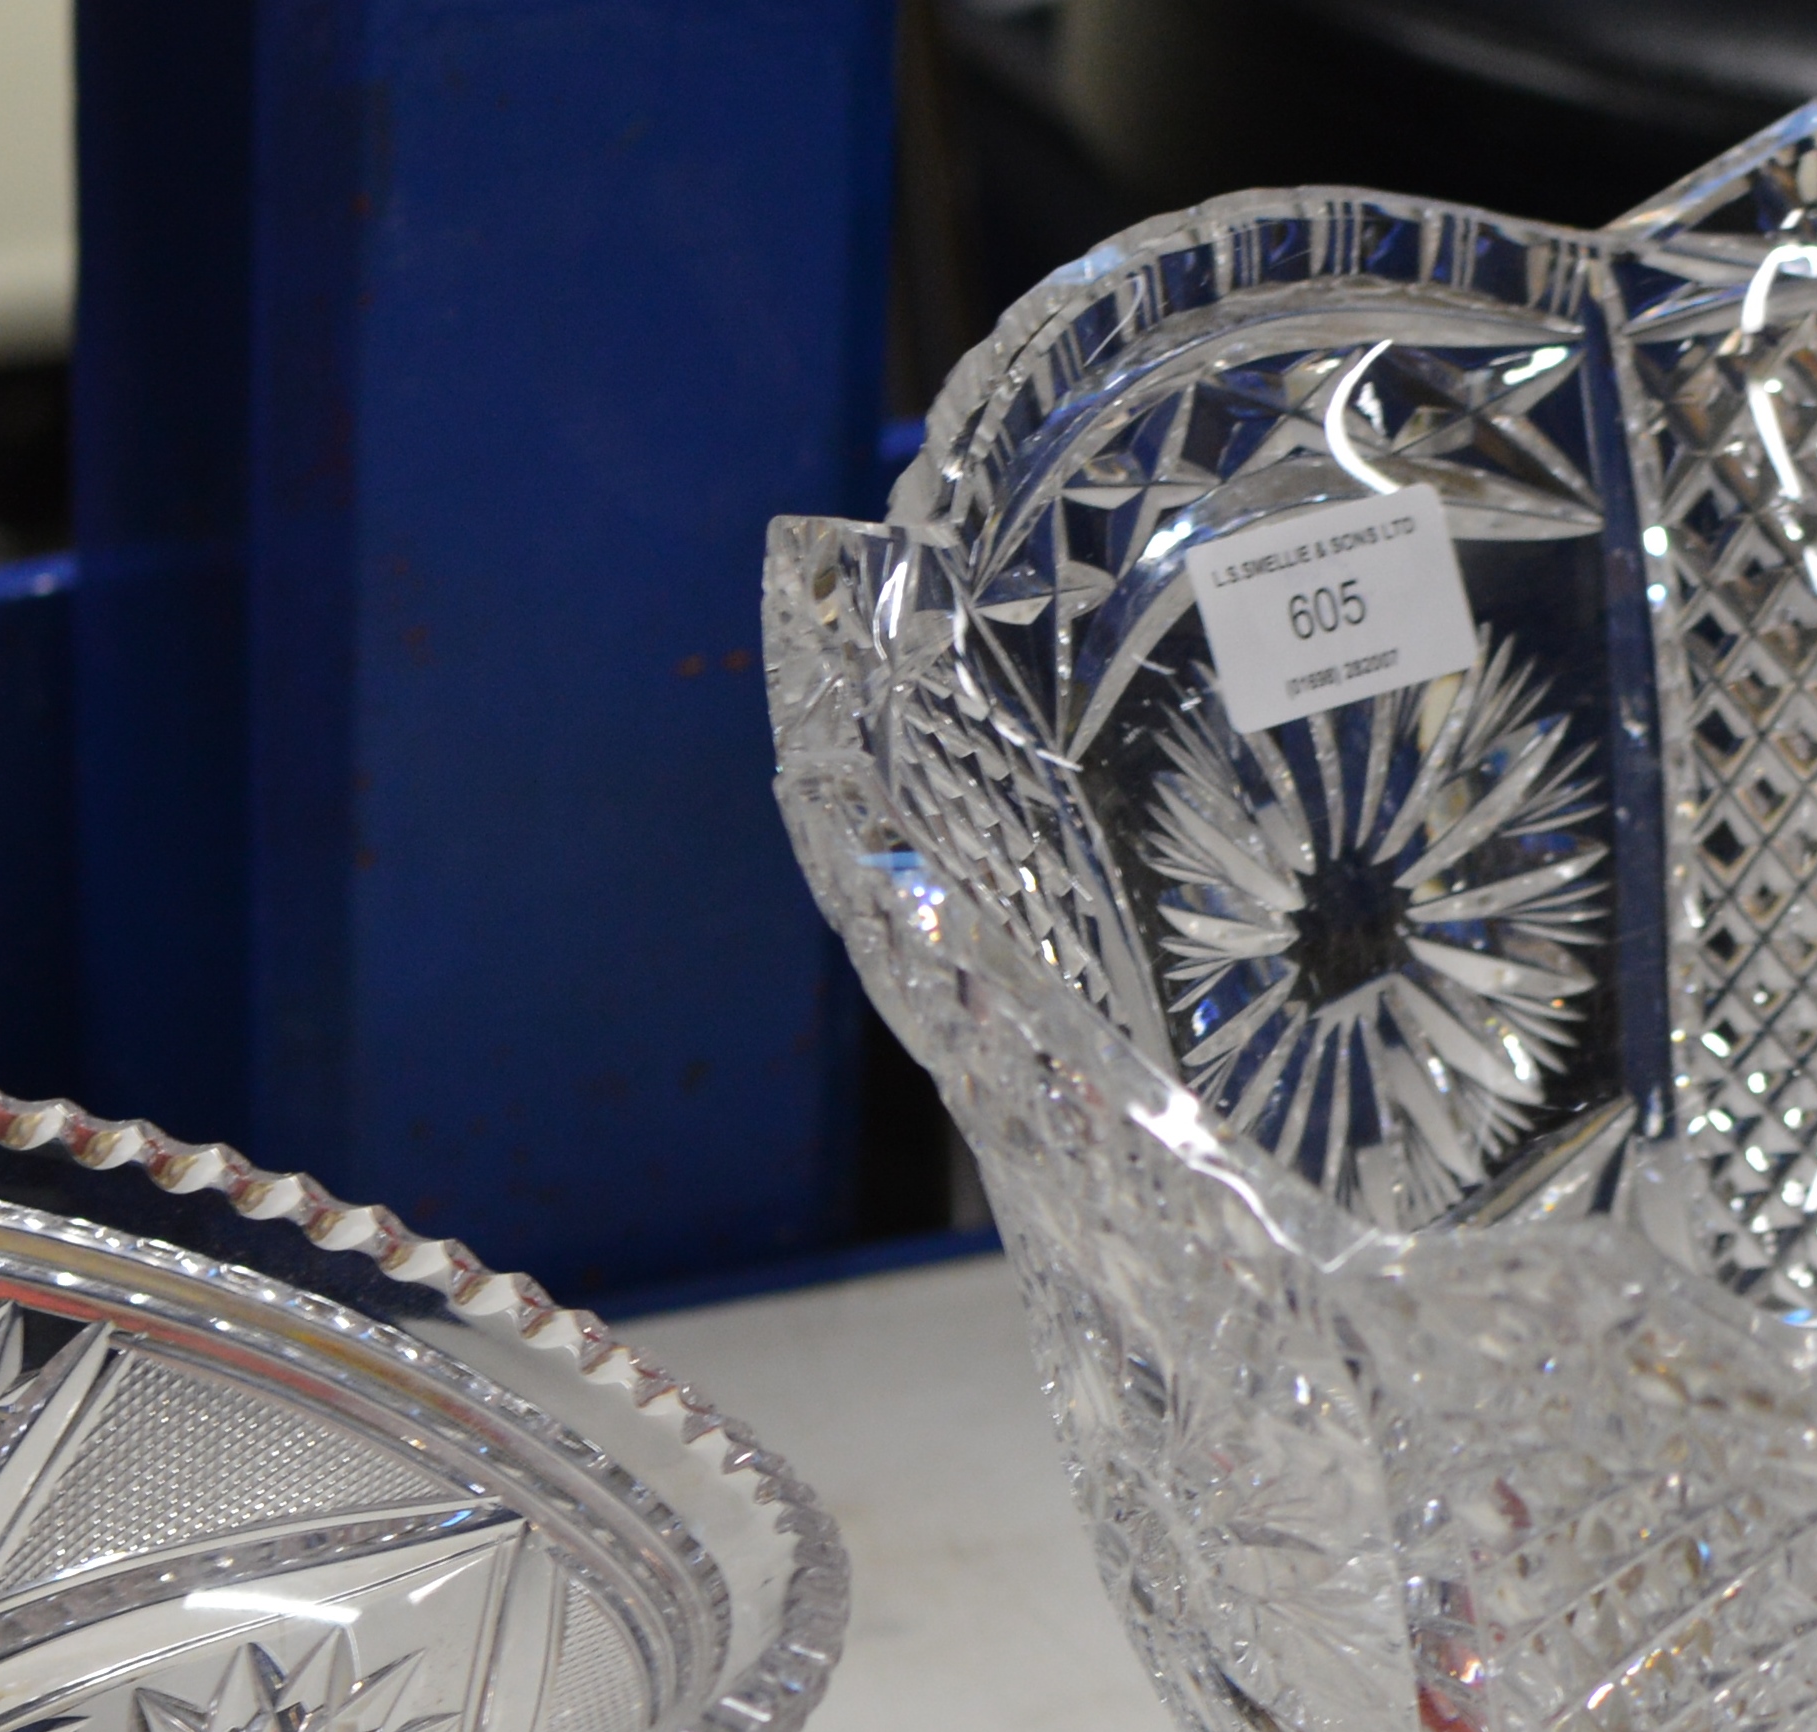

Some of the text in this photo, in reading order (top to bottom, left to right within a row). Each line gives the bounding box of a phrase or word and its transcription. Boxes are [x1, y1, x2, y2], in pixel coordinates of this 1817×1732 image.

[1316, 541, 1327, 559] &
[1331, 526, 1378, 553] SONS
[1383, 516, 1416, 541] LTD
[1288, 579, 1367, 640] 605
